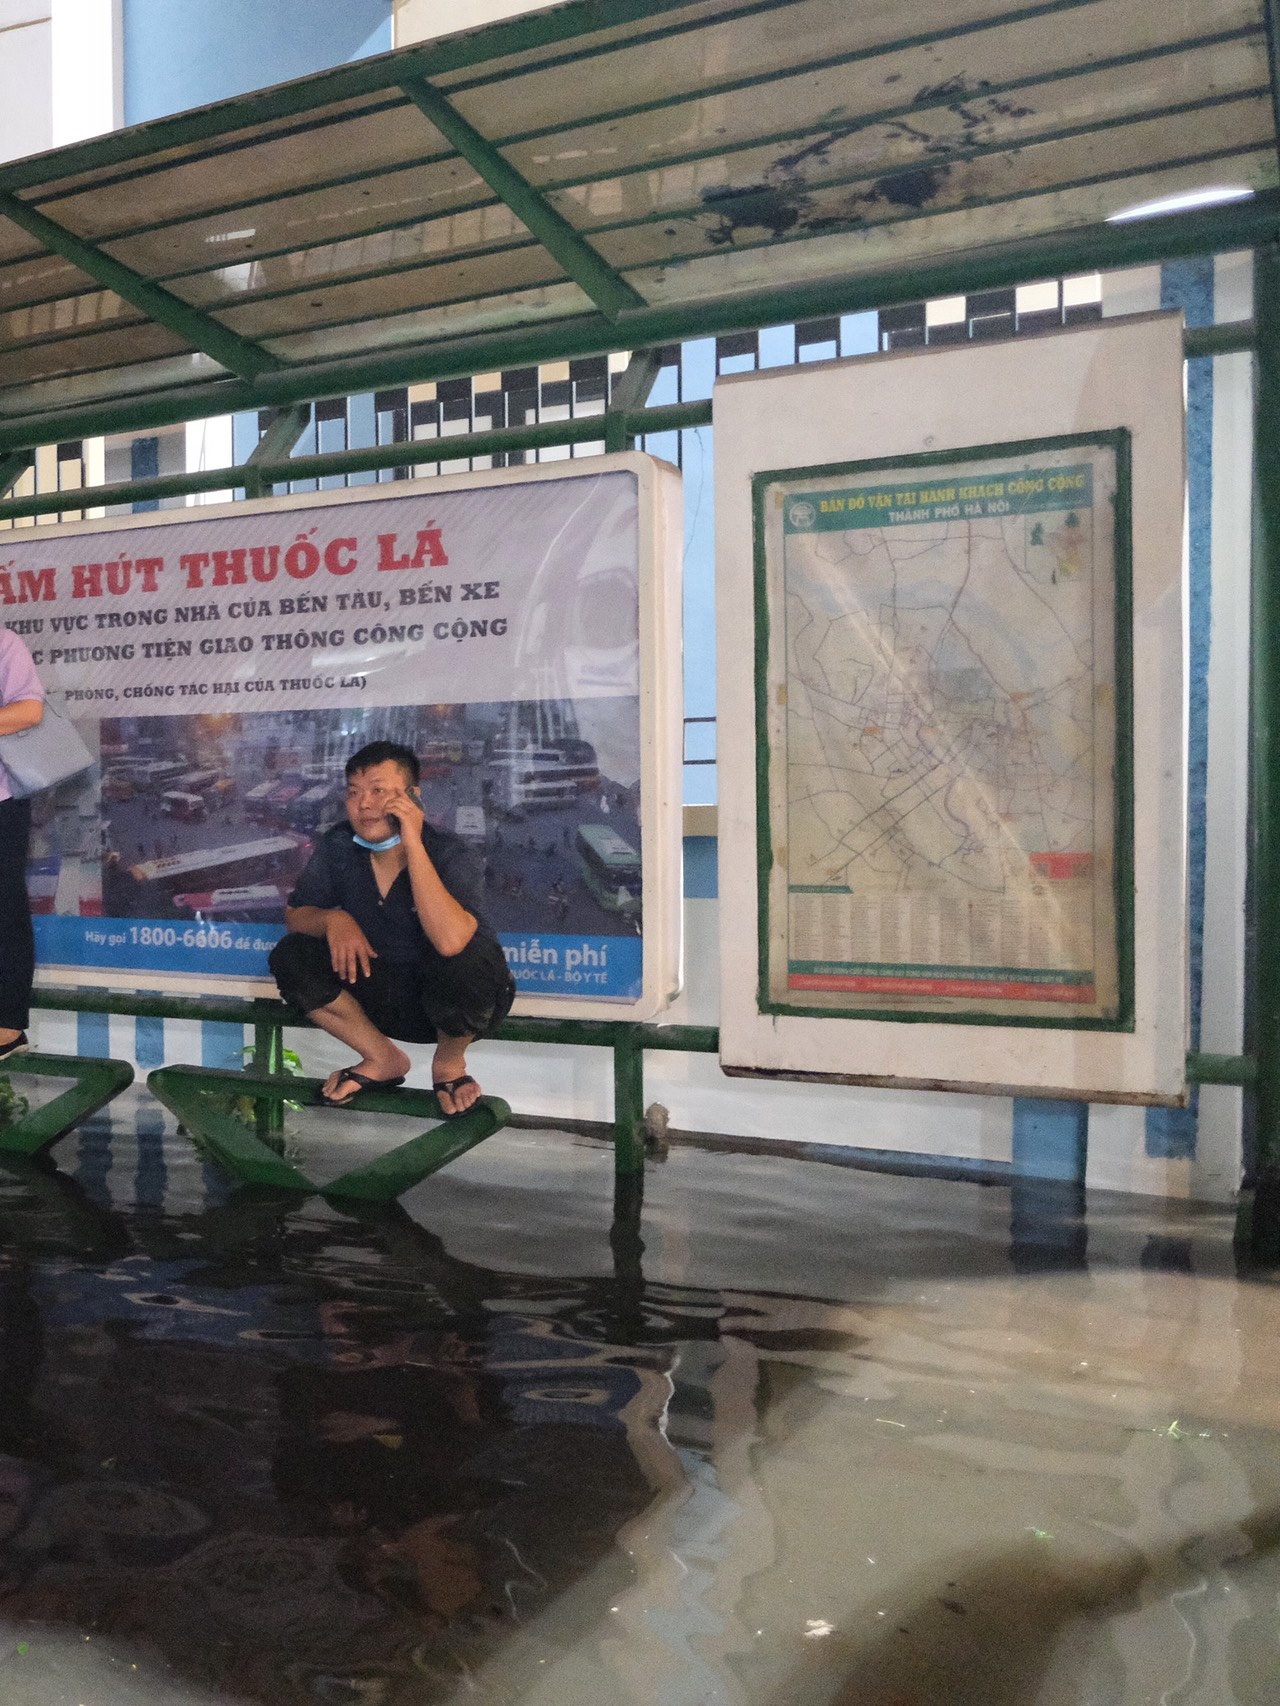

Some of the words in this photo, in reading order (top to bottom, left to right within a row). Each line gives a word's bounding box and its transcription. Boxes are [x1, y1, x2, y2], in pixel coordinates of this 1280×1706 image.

[71, 552, 165, 599] HÚT
[180, 527, 358, 590] THUỐC
[376, 519, 449, 572] LÁ
[50, 613, 89, 635] VỰC
[95, 608, 168, 630] TRONG
[174, 601, 220, 624] NHÀ
[228, 595, 273, 619] CỦA
[279, 590, 329, 616] BẾN
[336, 588, 391, 612] TÀU,
[399, 579, 452, 606] BẾN
[460, 580, 500, 601] XE
[141, 637, 193, 661] TIỆN
[200, 635, 254, 656] GIAO
[261, 628, 346, 652] THÔNG
[353, 622, 425, 646] CÔNG
[433, 616, 508, 643] CỘNG
[123, 682, 175, 699] CHỐNG
[179, 680, 208, 696] TÁC
[212, 680, 240, 697] HẠI
[244, 676, 275, 693] CỦA
[279, 673, 335, 691] THUỐC
[85, 930, 107, 946] Hãy
[129, 926, 232, 949] 1800-6606
[565, 943, 608, 970] phí
